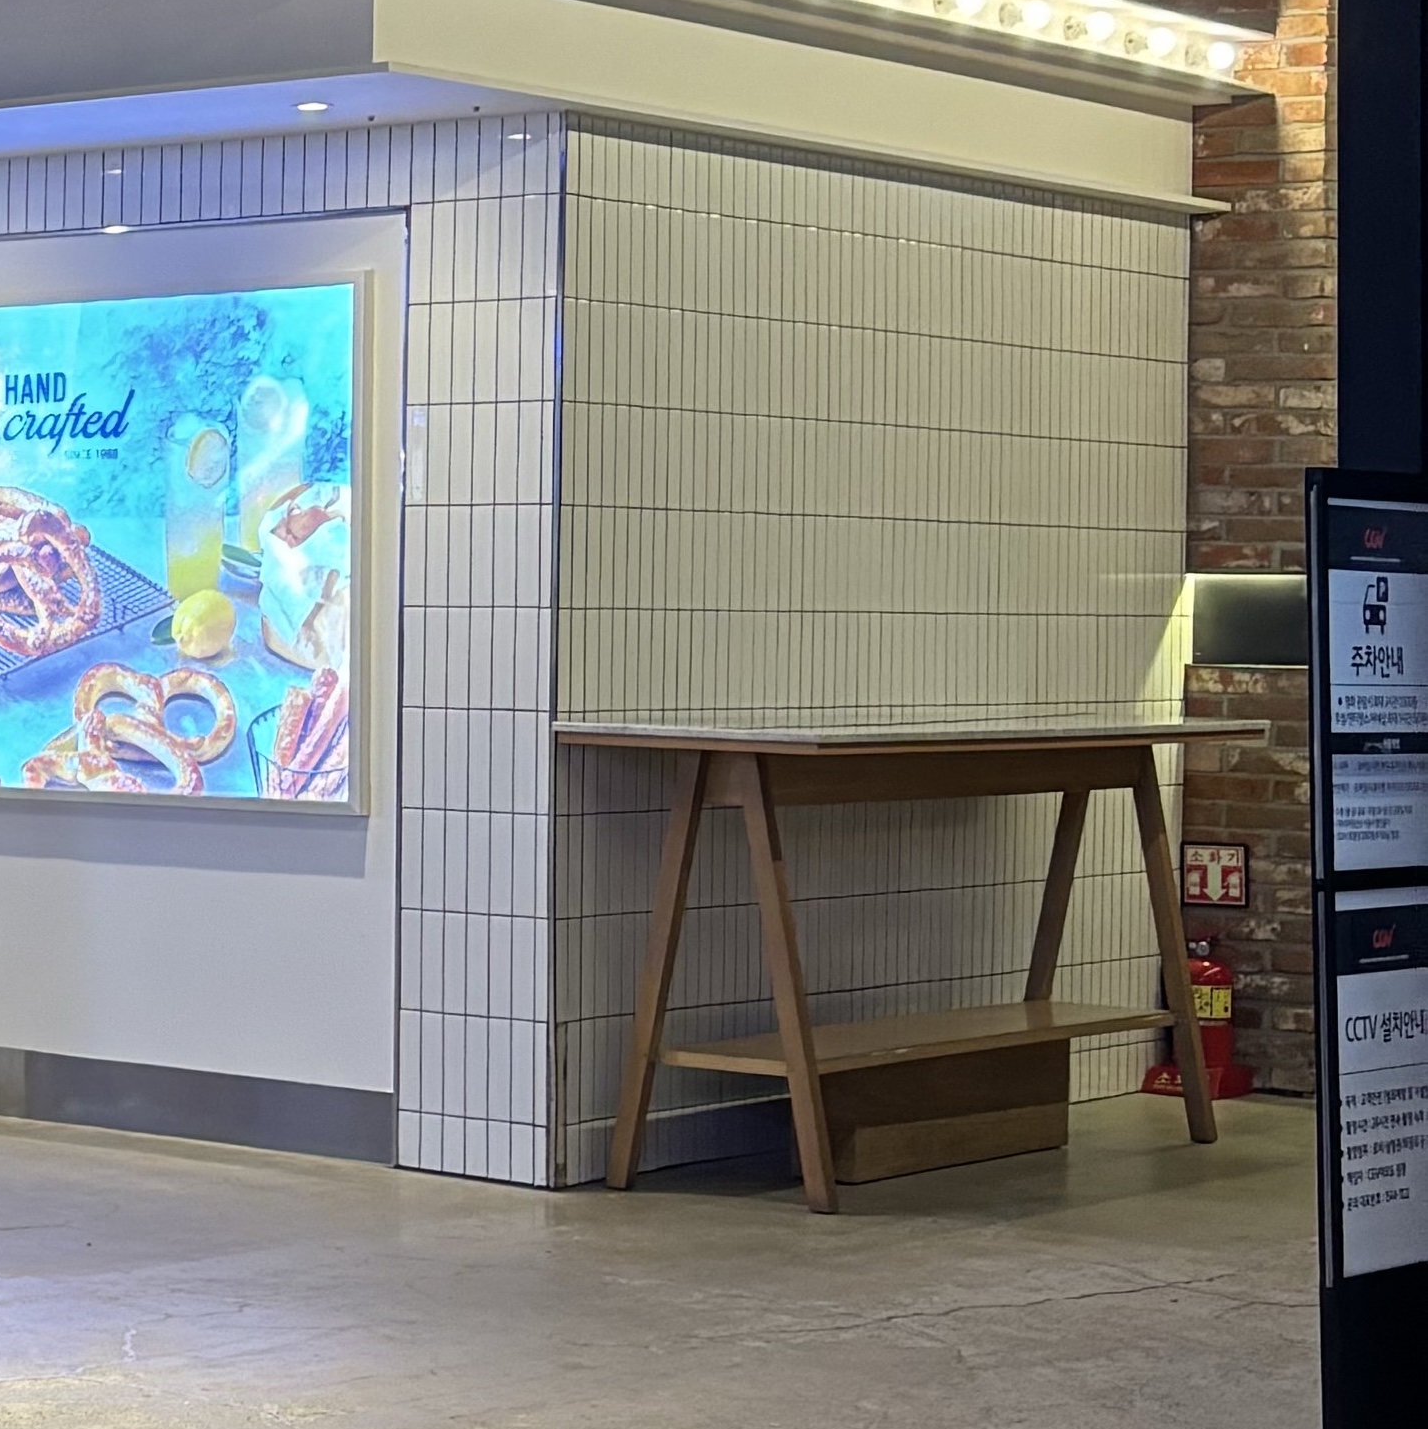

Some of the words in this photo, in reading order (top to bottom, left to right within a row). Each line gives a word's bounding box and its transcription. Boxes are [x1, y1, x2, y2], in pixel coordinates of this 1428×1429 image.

[4, 371, 67, 406] HAND
[2, 388, 136, 458] crafted
[1351, 645, 1404, 678] 주차안내
[1345, 1015, 1378, 1042] CCTV
